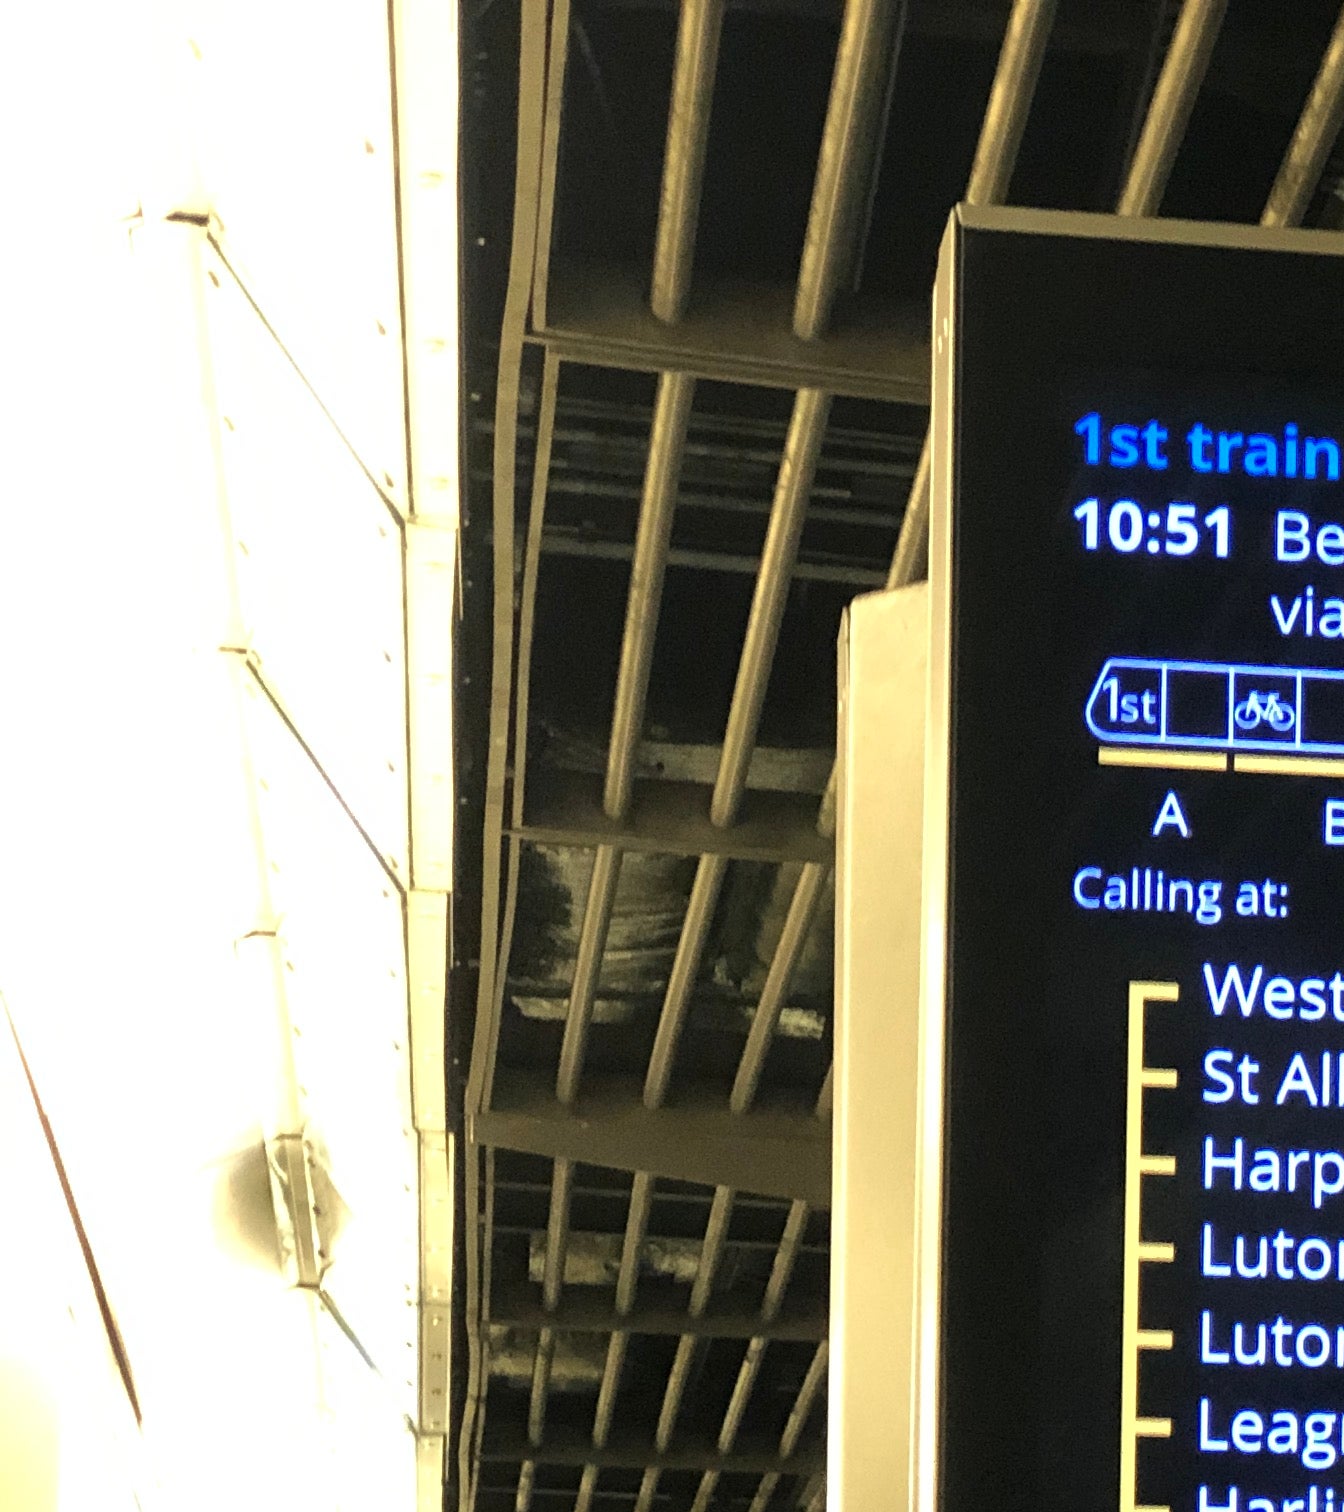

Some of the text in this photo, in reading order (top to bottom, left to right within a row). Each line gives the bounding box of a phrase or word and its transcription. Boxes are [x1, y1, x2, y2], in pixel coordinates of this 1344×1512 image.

[1074, 411, 1342, 481] 1st train
[1072, 495, 1232, 559] 10:51
[1102, 676, 1156, 724] 1st
[1151, 789, 1192, 838] A
[1073, 865, 1289, 926] Calling at:
[1202, 1046, 1260, 1106] St
